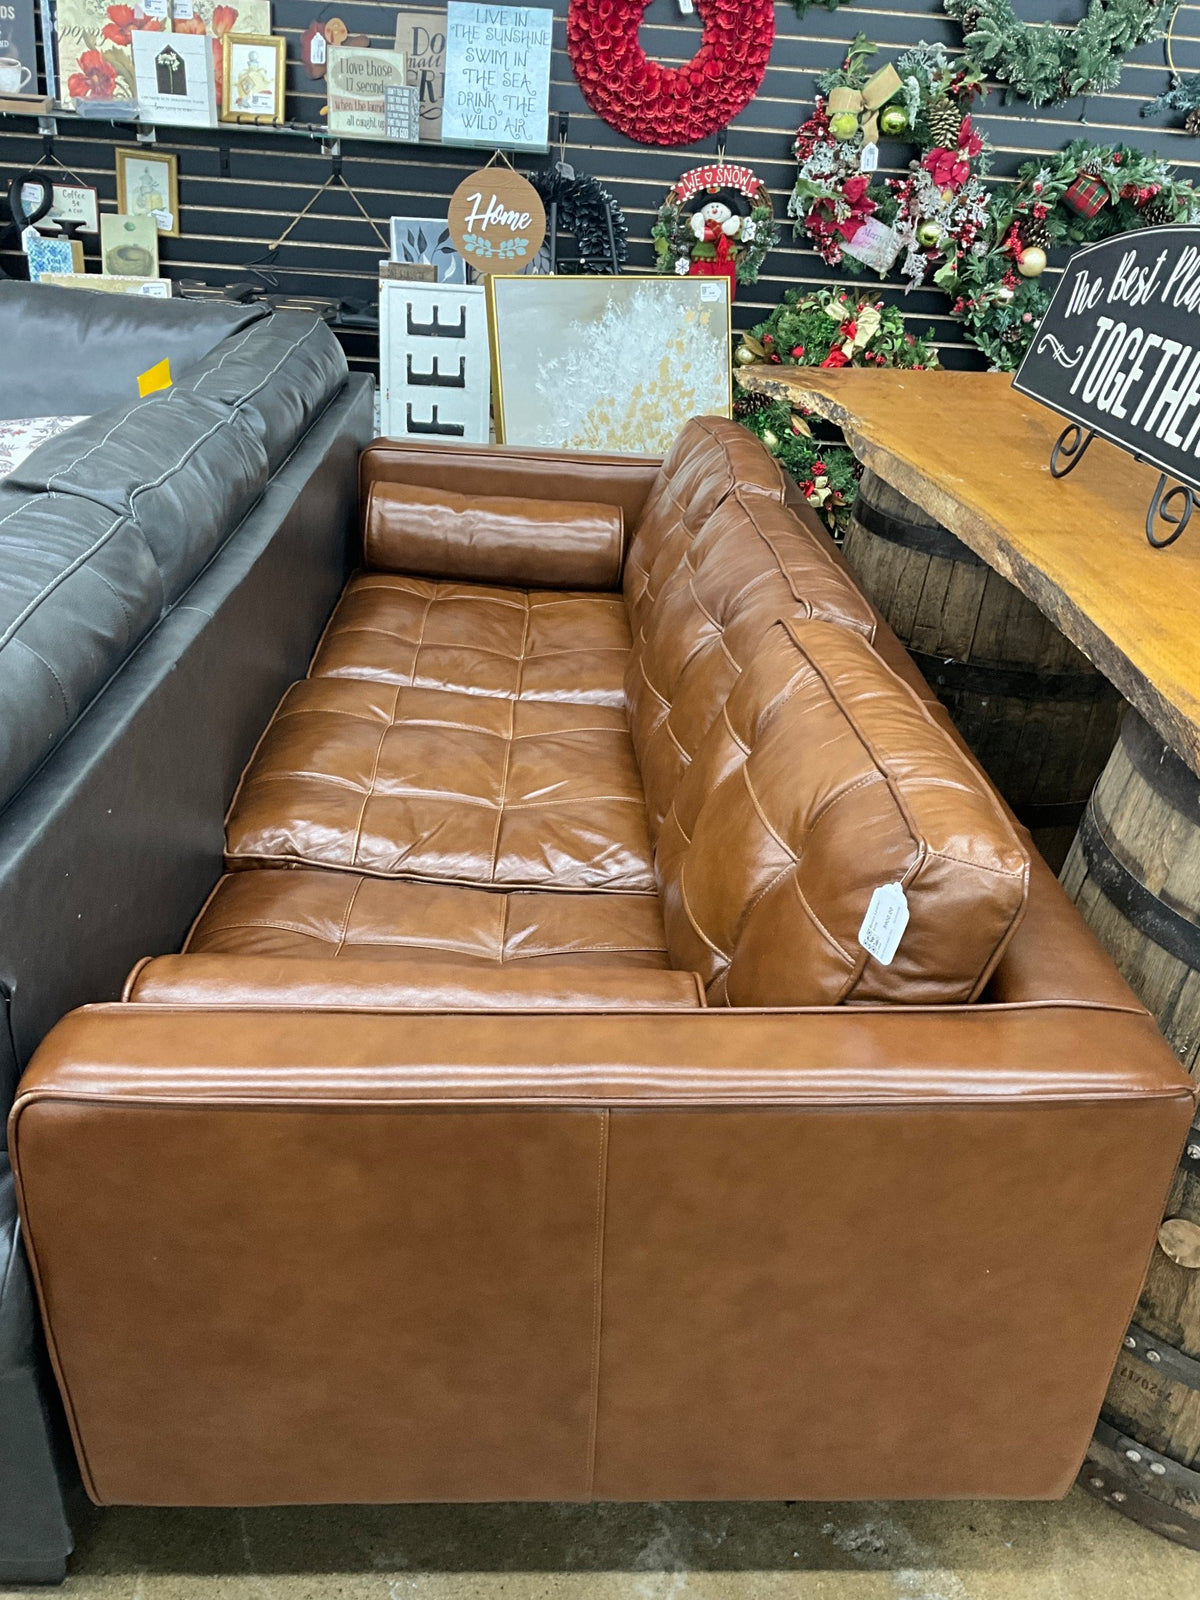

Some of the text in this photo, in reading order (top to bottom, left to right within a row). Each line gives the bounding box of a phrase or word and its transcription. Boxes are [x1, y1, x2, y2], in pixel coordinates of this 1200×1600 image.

[476, 8, 529, 27] LIVE IN
[450, 23, 551, 49] THE SUNSHINE
[340, 58, 393, 78] I love those
[465, 47, 529, 72] SWIM IN
[346, 77, 354, 91] 17
[462, 68, 496, 92] THE
[502, 72, 537, 96] SEA
[334, 99, 354, 111] when
[354, 100, 366, 112] the
[457, 90, 537, 118] DRINK THE
[346, 114, 355, 126] all
[356, 117, 377, 130] caught
[461, 113, 534, 141] WILD AIR
[683, 168, 751, 190] WE SNOW
[62, 189, 86, 200] Coffee
[464, 192, 533, 233] Home
[1064, 245, 1200, 319] The Best Pla
